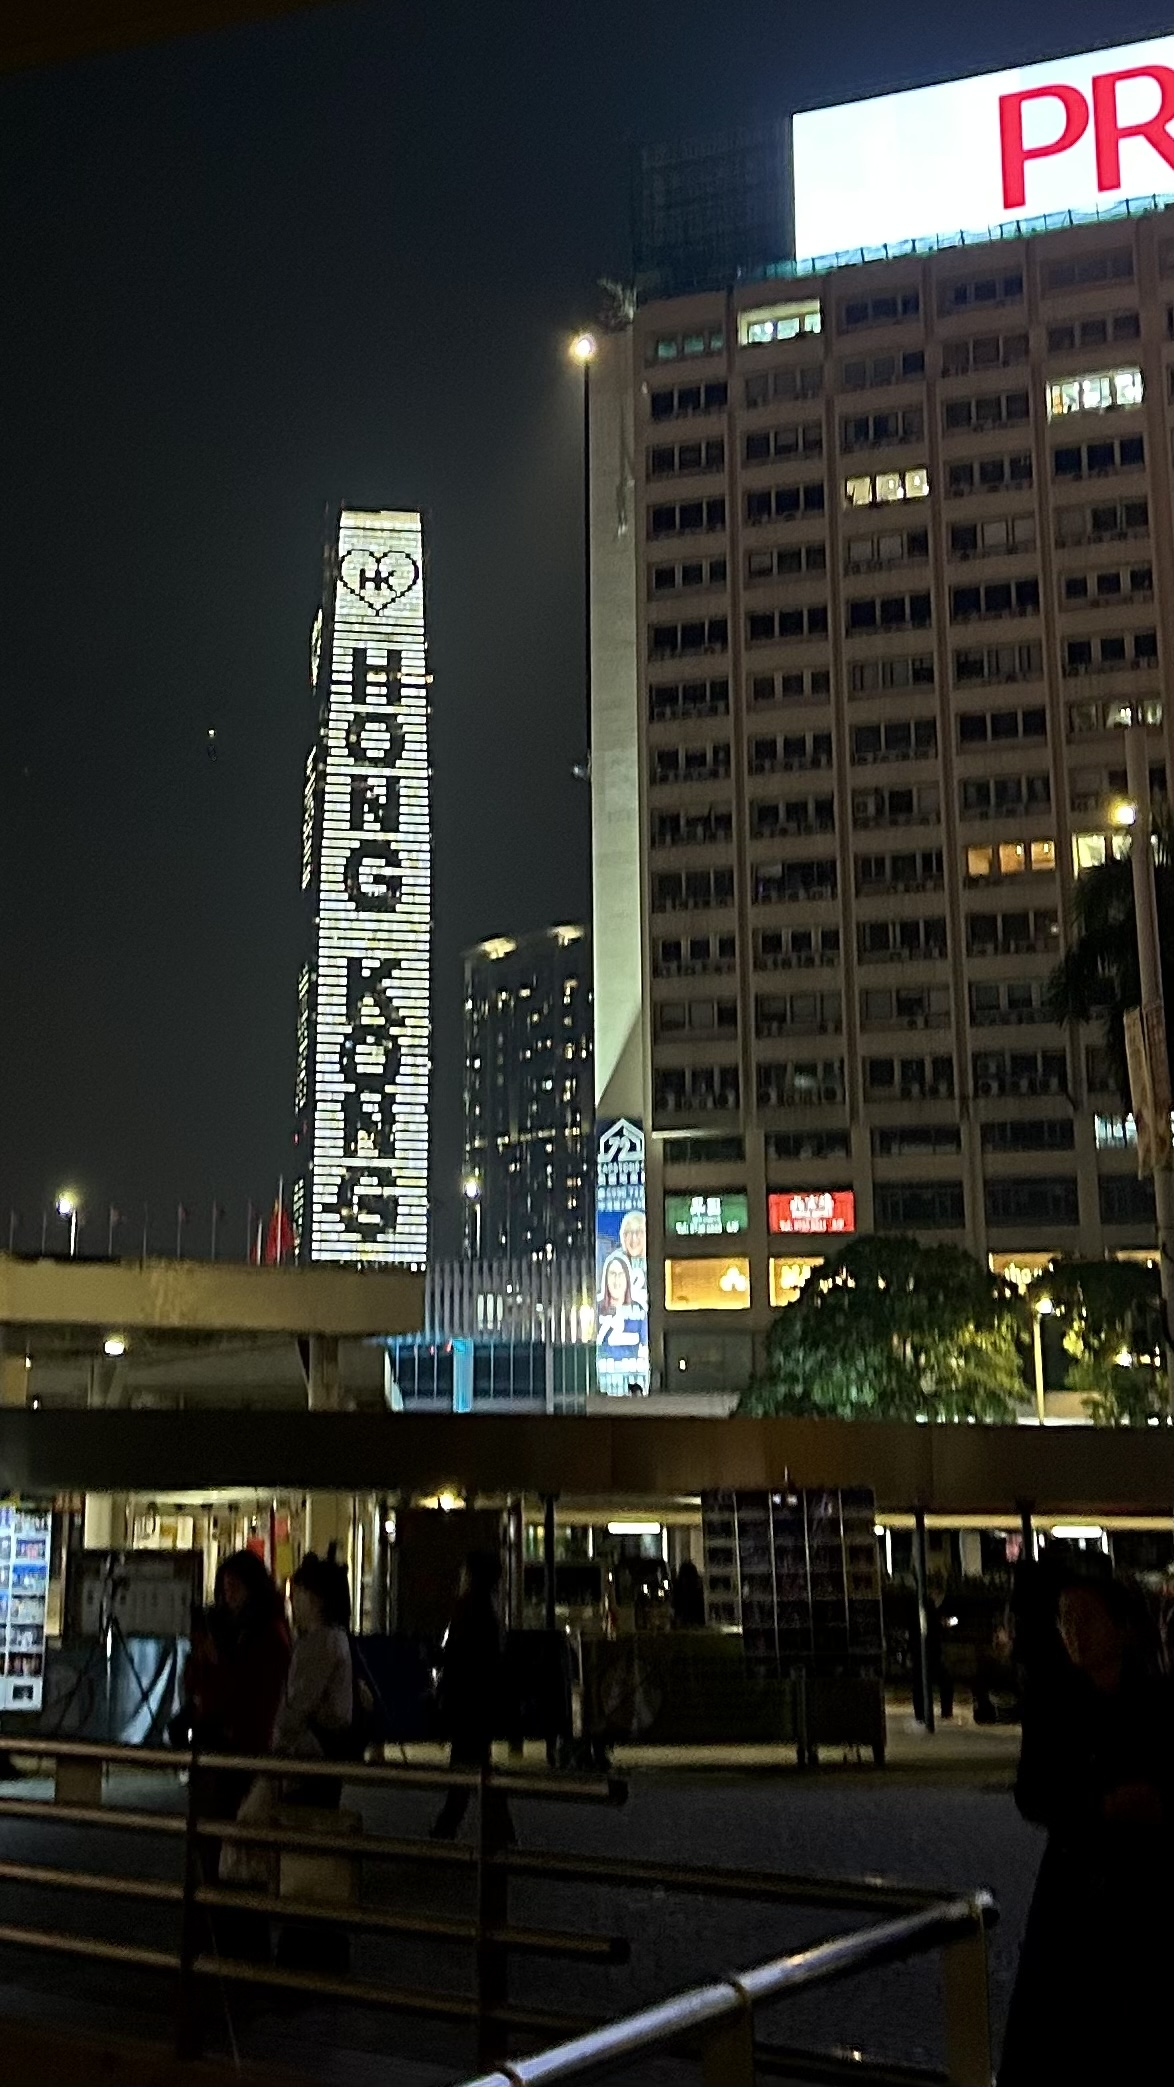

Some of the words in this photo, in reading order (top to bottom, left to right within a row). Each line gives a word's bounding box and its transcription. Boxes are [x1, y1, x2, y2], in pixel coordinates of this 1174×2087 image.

[999, 64, 1174, 210] PR
[359, 567, 397, 595] HK
[345, 647, 404, 911] HONG
[337, 957, 402, 1237] KONG
